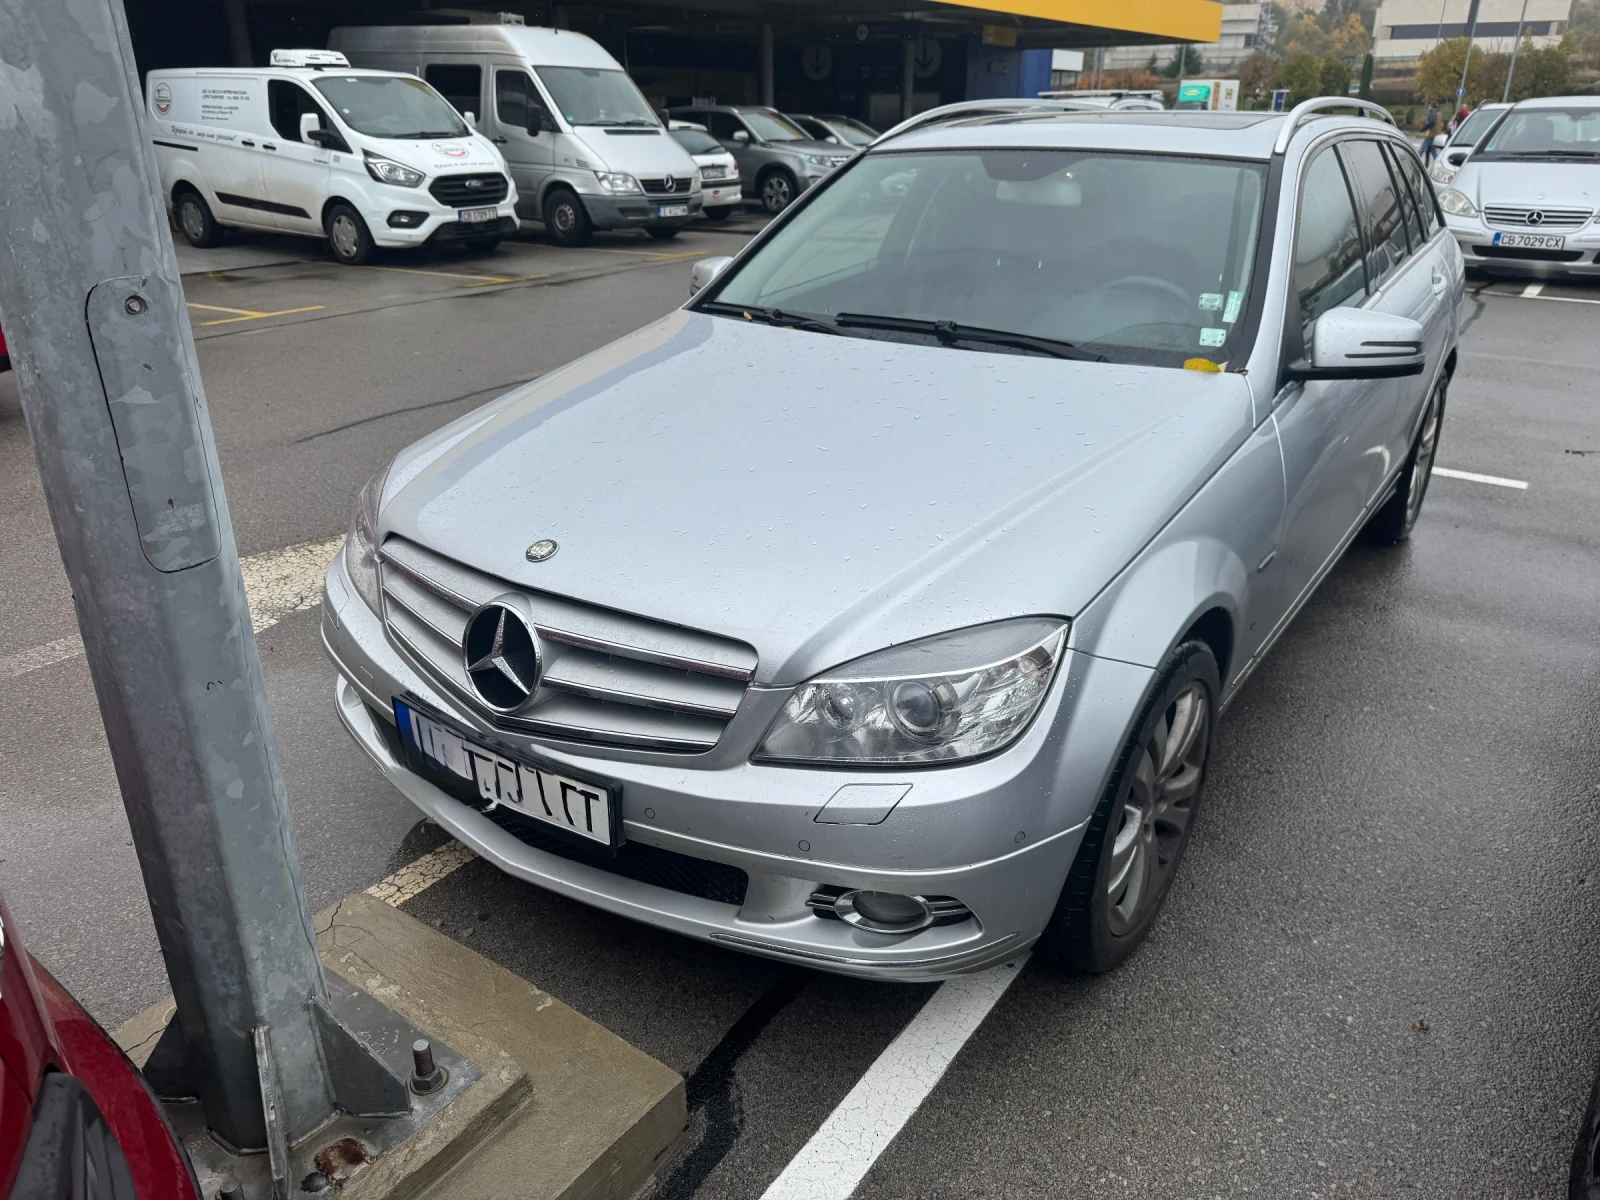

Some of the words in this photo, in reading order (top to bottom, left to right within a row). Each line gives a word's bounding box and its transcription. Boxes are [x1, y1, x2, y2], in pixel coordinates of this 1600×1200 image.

[1501, 234, 1515, 245] CB
[1517, 235, 1544, 247] 7029
[1545, 237, 1562, 248] CX
